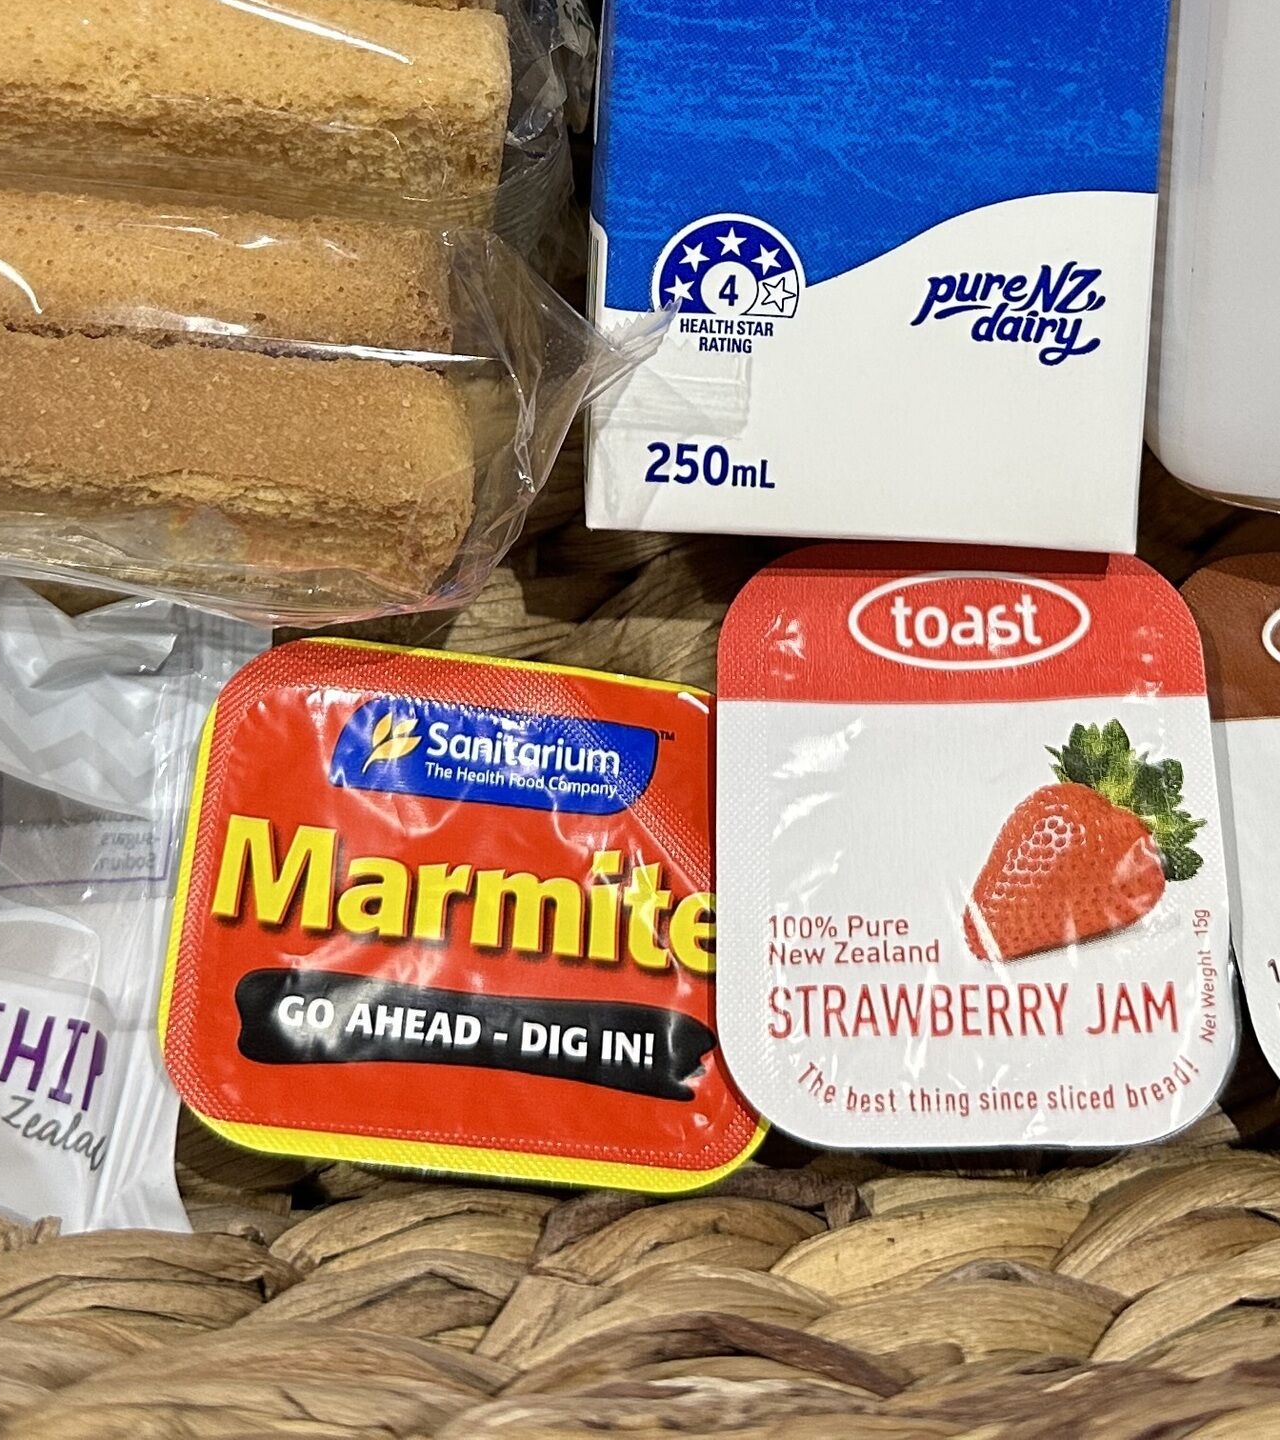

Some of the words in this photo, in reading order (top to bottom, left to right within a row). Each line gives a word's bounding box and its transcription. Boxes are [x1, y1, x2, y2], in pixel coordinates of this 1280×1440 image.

[719, 275, 738, 307] 4
[680, 318, 734, 336] HEALTH
[736, 319, 774, 337] STAR
[698, 335, 753, 354] RATING
[970, 312, 1102, 366] dairy
[644, 441, 776, 489] 250mL
[889, 593, 1044, 648] toast
[426, 721, 620, 777] Sanitarium
[425, 761, 452, 779] The
[457, 767, 505, 786] Health
[509, 774, 544, 790] Food
[548, 776, 618, 798] Company
[209, 812, 717, 974] Marmite
[767, 915, 838, 940] 100%
[847, 914, 909, 938] Pure
[1193, 909, 1210, 936] 15g
[767, 943, 825, 967] New
[833, 939, 940, 965] Zealand
[277, 995, 334, 1031] GO
[347, 1002, 482, 1048] AHEAD
[520, 1019, 589, 1057] DIG
[600, 1029, 655, 1065] IN!
[766, 981, 1070, 1040] STRAWBERRY
[1085, 981, 1180, 1036] JAM
[1199, 1013, 1217, 1043] Net
[797, 1061, 837, 1103] The
[846, 1086, 896, 1113] best
[909, 1088, 969, 1117] thing
[979, 1085, 1037, 1110] since
[1047, 1083, 1115, 1110] sliced
[1127, 1055, 1199, 1108] bread!
